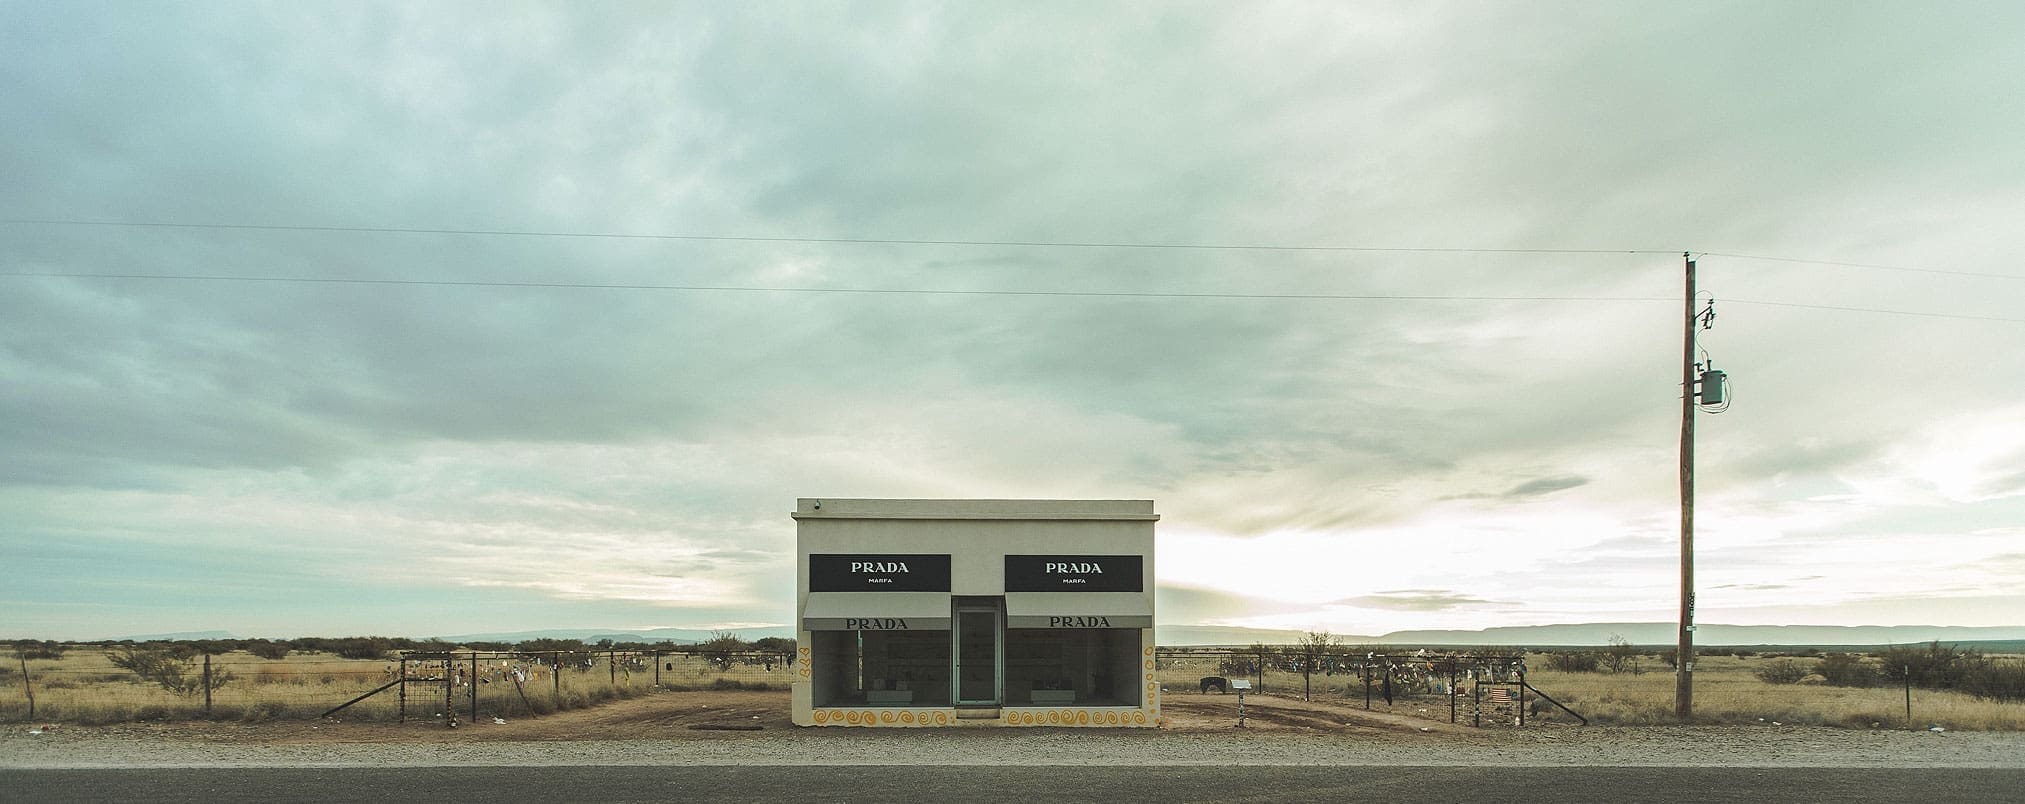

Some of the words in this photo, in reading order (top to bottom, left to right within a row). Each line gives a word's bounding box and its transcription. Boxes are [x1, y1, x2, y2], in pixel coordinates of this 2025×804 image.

[851, 562, 909, 573] PRADA
[1046, 562, 1103, 574] PRADA
[846, 618, 908, 630] PRADA
[1050, 616, 1110, 628] PRADA
